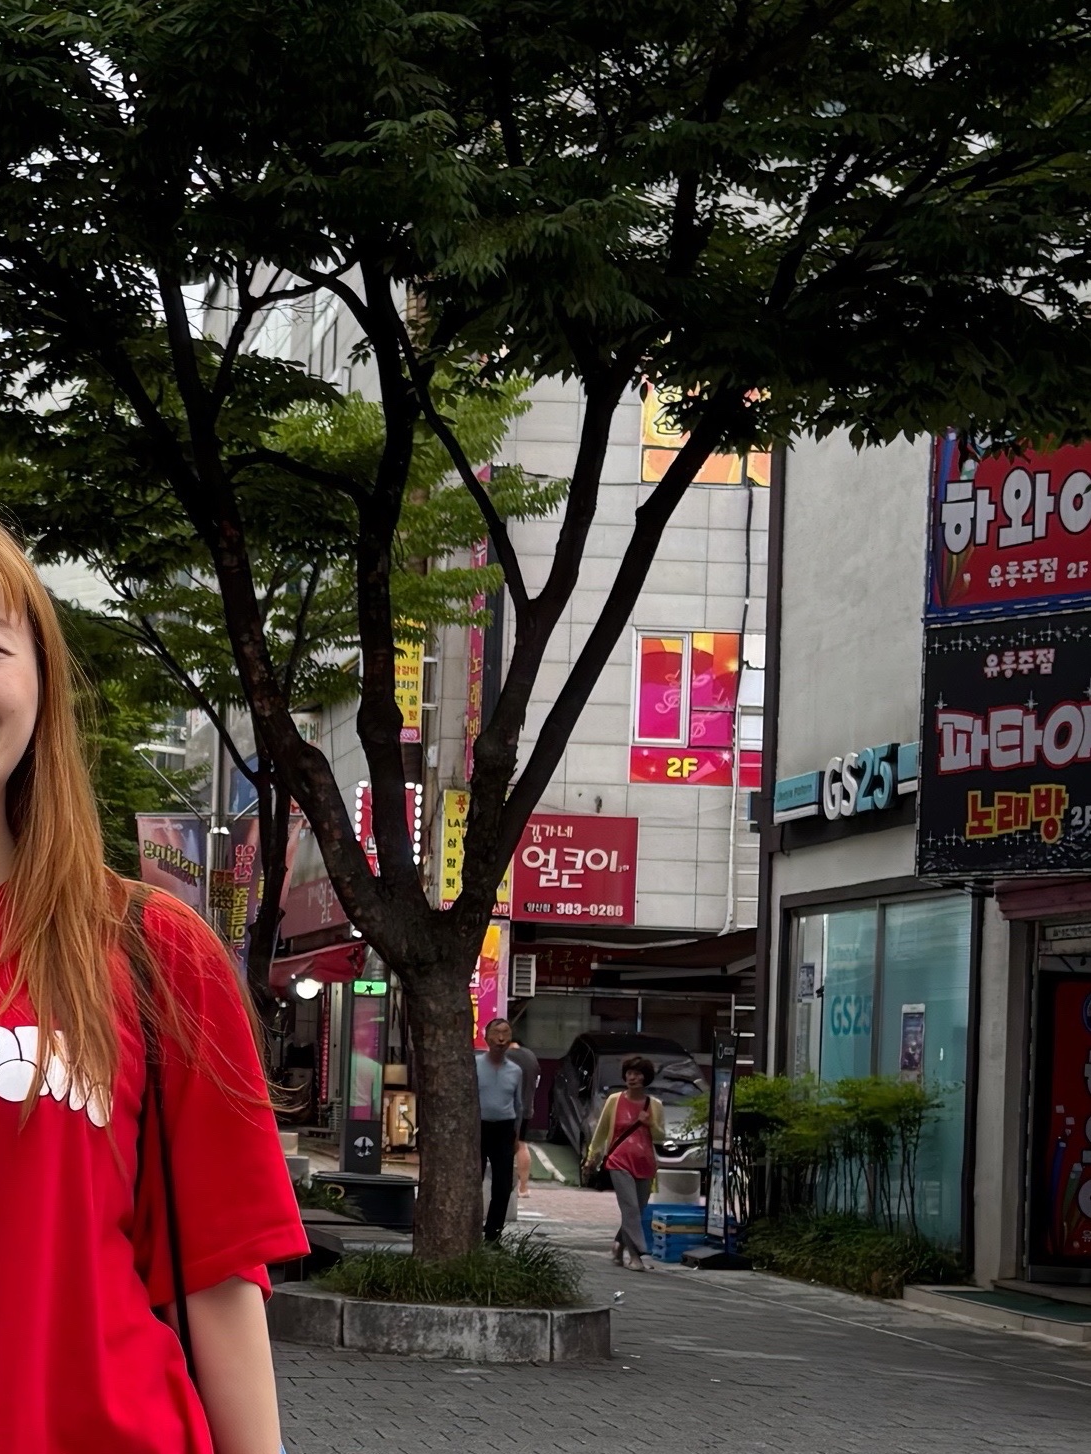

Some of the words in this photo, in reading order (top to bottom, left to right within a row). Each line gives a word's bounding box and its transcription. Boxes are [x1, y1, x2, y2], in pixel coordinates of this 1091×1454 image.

[988, 557, 1058, 587] 유흥주점
[1067, 560, 1089, 579] 2F
[983, 649, 1056, 678] 유흥주점
[666, 757, 698, 779] 2F
[823, 747, 893, 821] GS25
[966, 783, 1069, 844] 노래방
[527, 824, 573, 843] 김가네
[522, 846, 618, 888] 얼큰이
